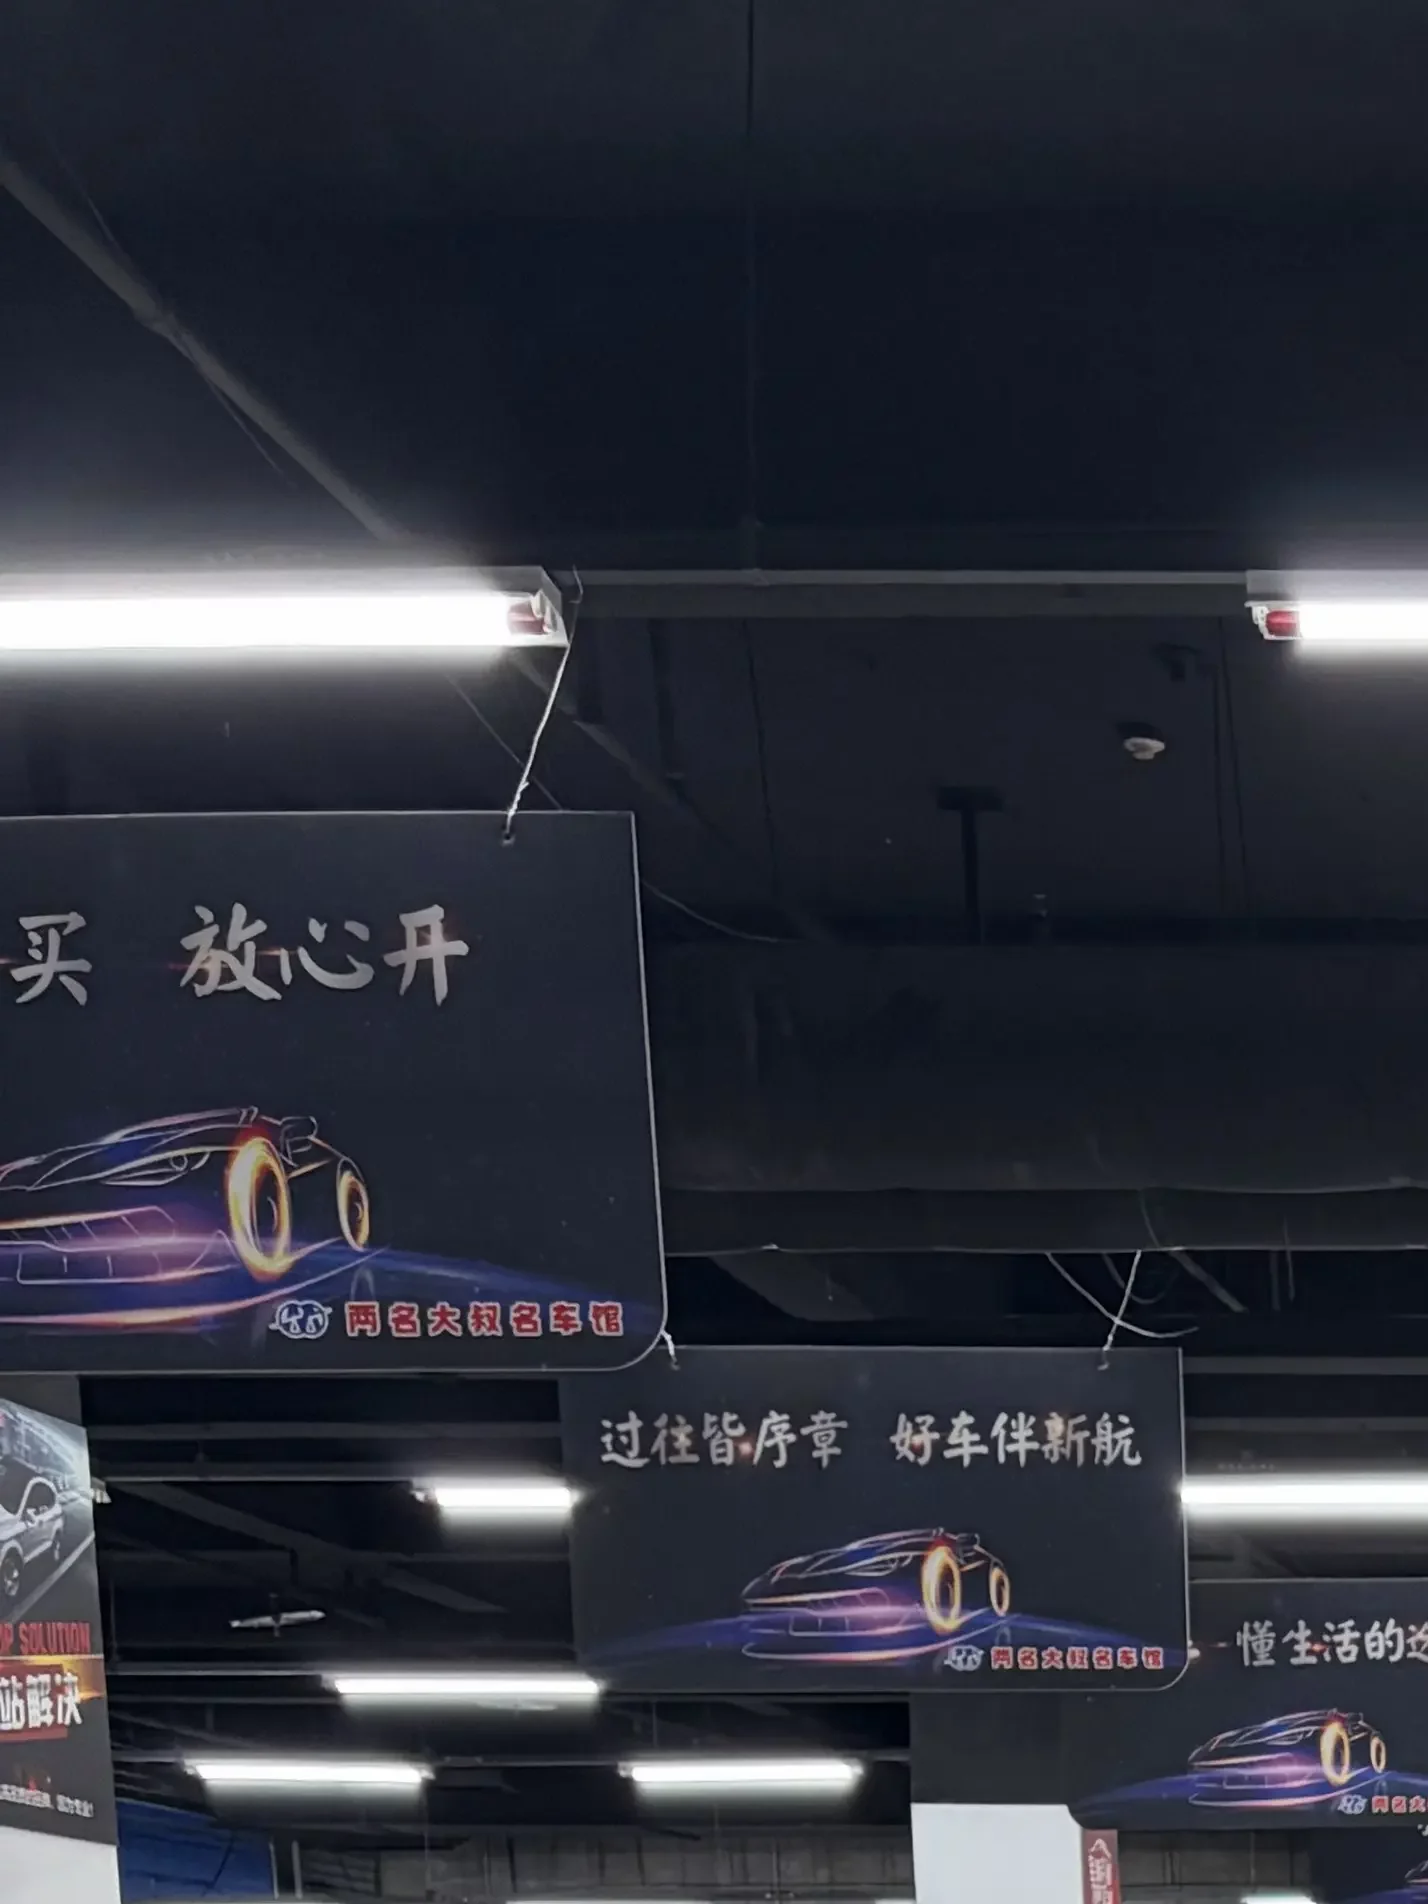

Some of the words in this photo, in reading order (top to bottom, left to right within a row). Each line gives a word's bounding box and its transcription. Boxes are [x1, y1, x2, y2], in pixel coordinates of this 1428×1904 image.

[11, 911, 92, 1006] 买
[179, 901, 470, 1006] 放心开
[345, 1301, 624, 1338] 两名大叔名车馆
[600, 1409, 849, 1469] 过往皆序章
[890, 1410, 1143, 1469] 好车伴新航
[19, 1621, 91, 1655] SOLUTION
